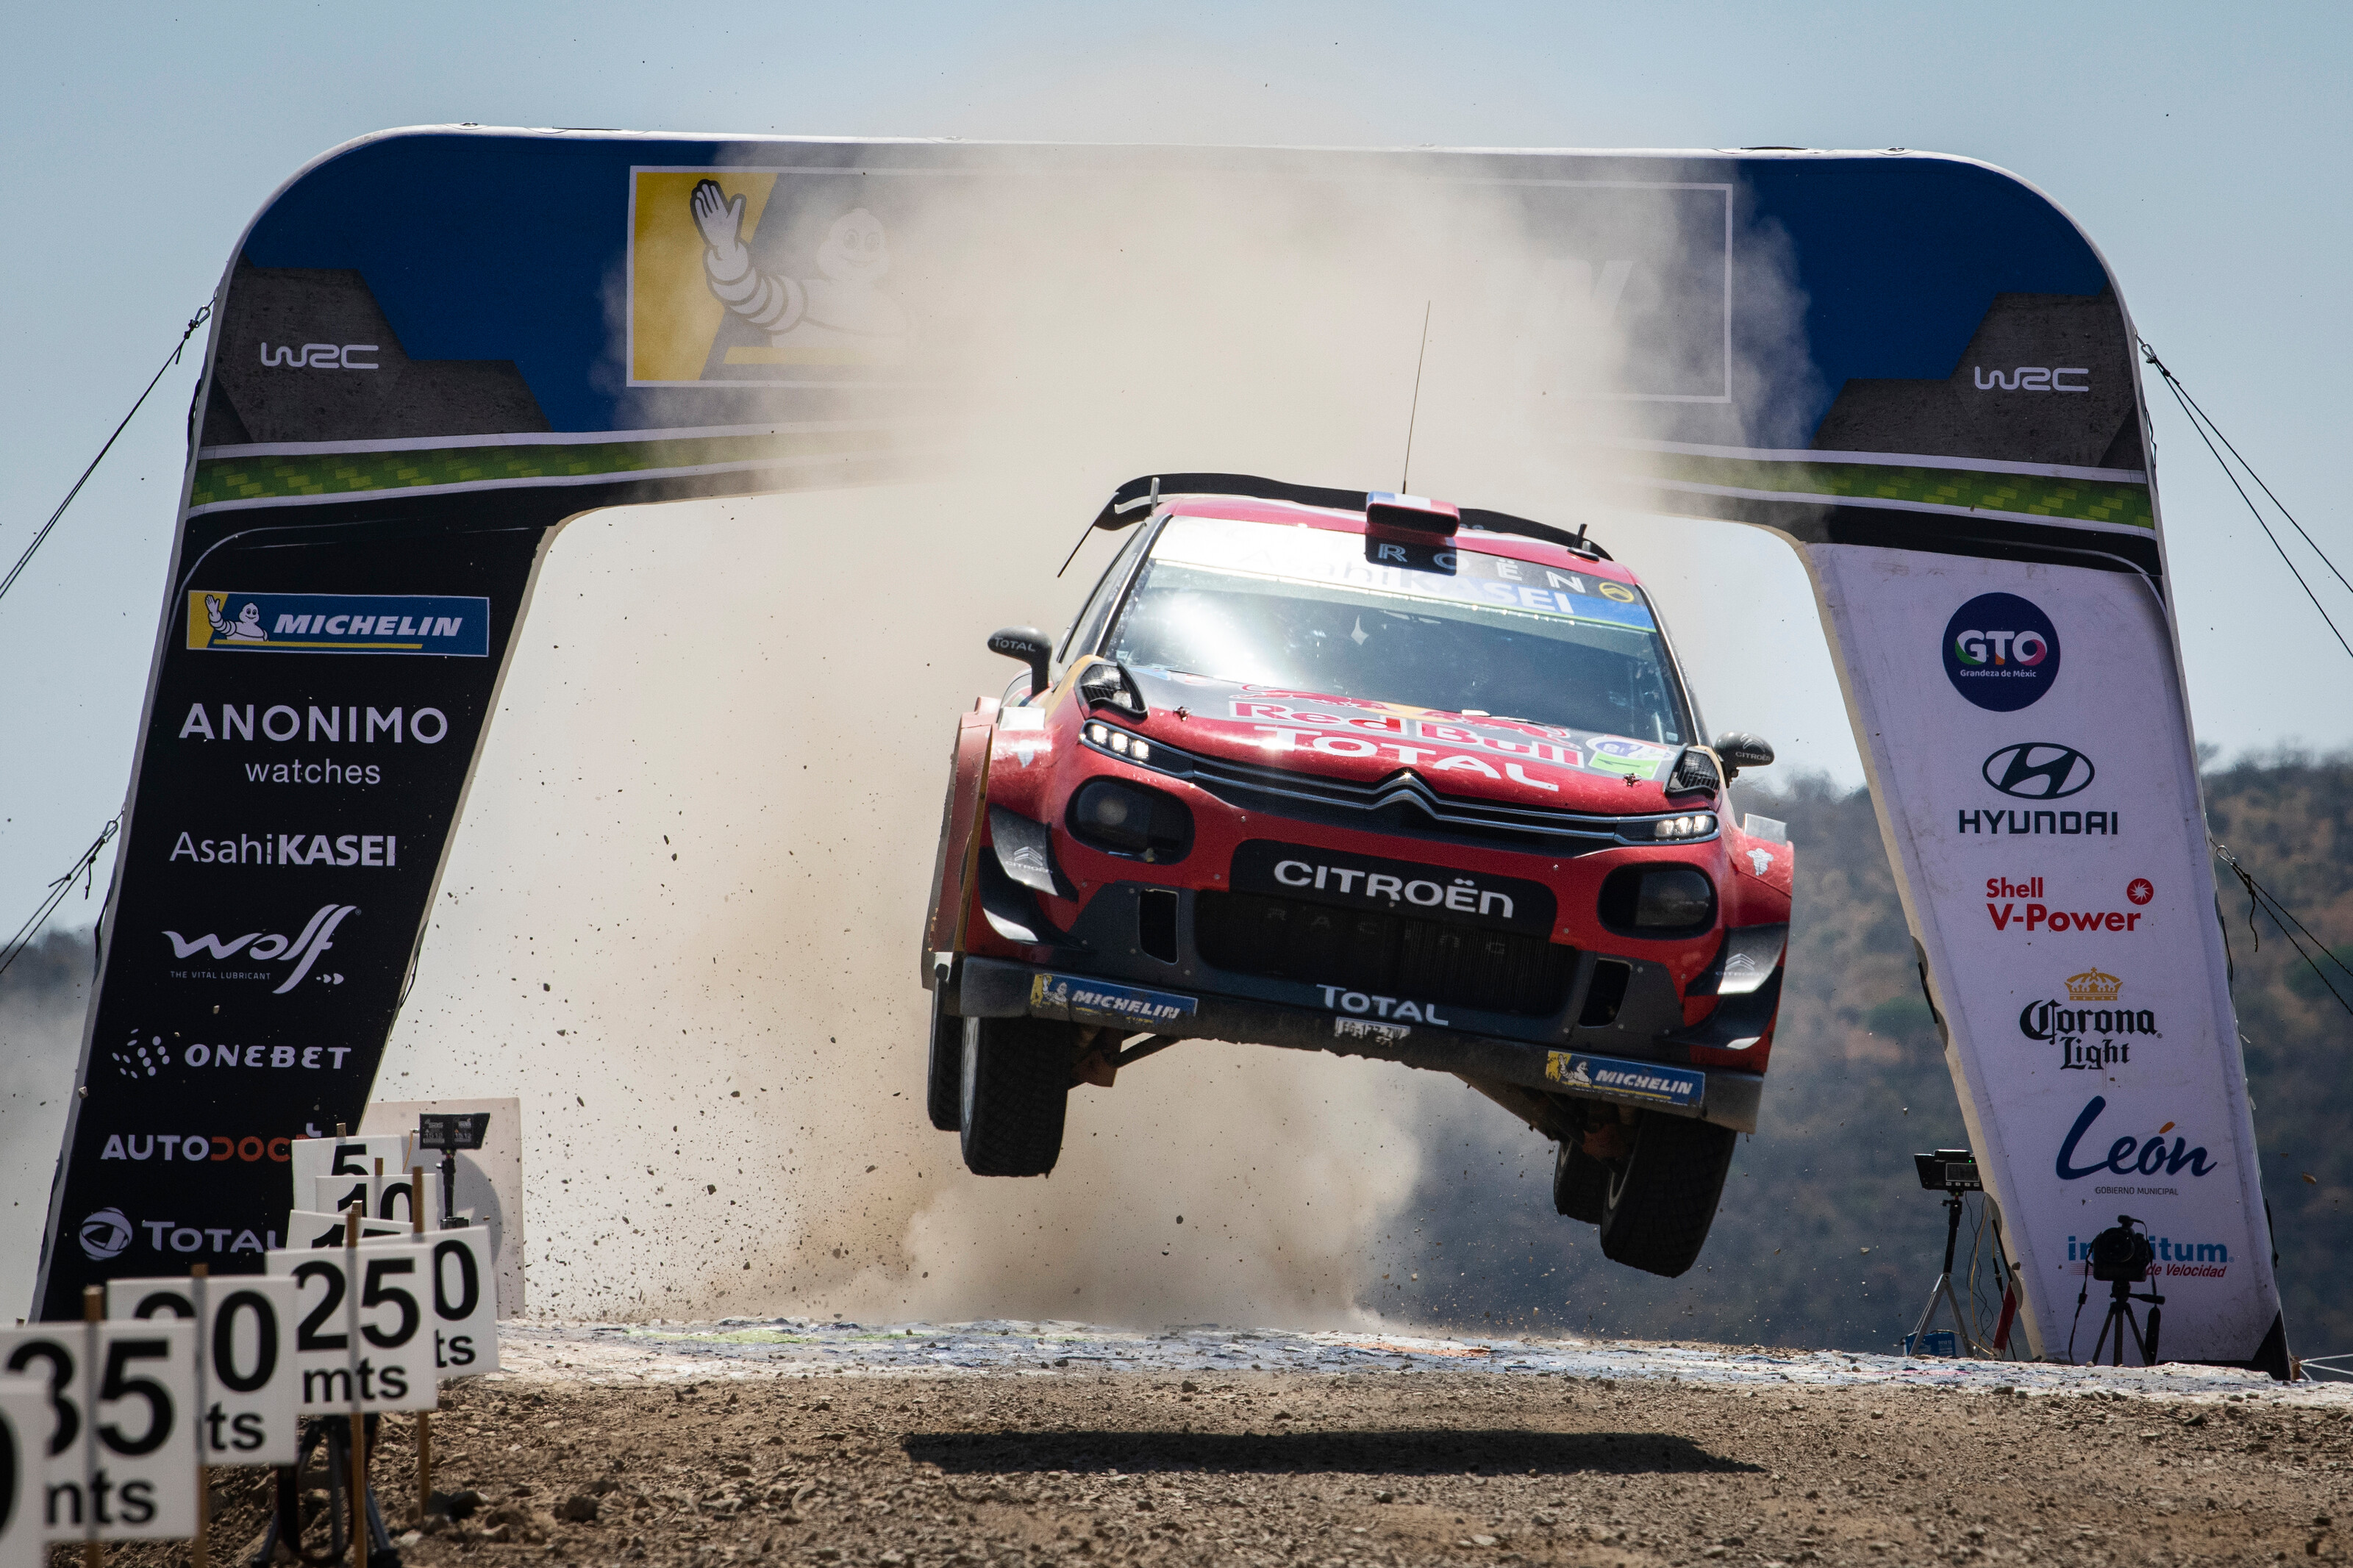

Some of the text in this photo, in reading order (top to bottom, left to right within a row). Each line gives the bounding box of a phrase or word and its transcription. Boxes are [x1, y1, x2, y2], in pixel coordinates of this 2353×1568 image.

[260, 342, 379, 369] WRC
[1974, 366, 2089, 392] WRC
[273, 614, 463, 637] MICHELIN
[994, 637, 1036, 652] TOTAL
[1954, 629, 2048, 666] GTO
[1960, 669, 1999, 677] Grandeza
[179, 703, 448, 744] ANONIMO
[1229, 700, 1585, 769] Red Bull
[245, 759, 381, 784] watches
[1254, 726, 1560, 792] TOTAL
[1958, 809, 2118, 835] HYUNDAI
[1986, 876, 2043, 898] Shell
[1986, 903, 2141, 931] V-Power
[170, 970, 271, 981] THE VITAL LUBRICANT
[1071, 989, 1181, 1020] MICHELIN
[1316, 984, 1449, 1027] TOTAL
[2019, 998, 2159, 1045] Corona
[184, 1043, 351, 1070] ONEBET
[2060, 1037, 2131, 1070] Light
[1595, 1067, 1693, 1095] MICHELIN
[2056, 1095, 2218, 1181] León
[2095, 1186, 2179, 1196] GOBIERNO MUNICIPAL
[432, 1239, 480, 1322] 0
[2165, 1264, 2227, 1278] Velocidad
[292, 1256, 421, 1350] 25
[435, 1329, 476, 1368] ts
[303, 1356, 410, 1405] mts
[206, 1400, 266, 1455] ts
